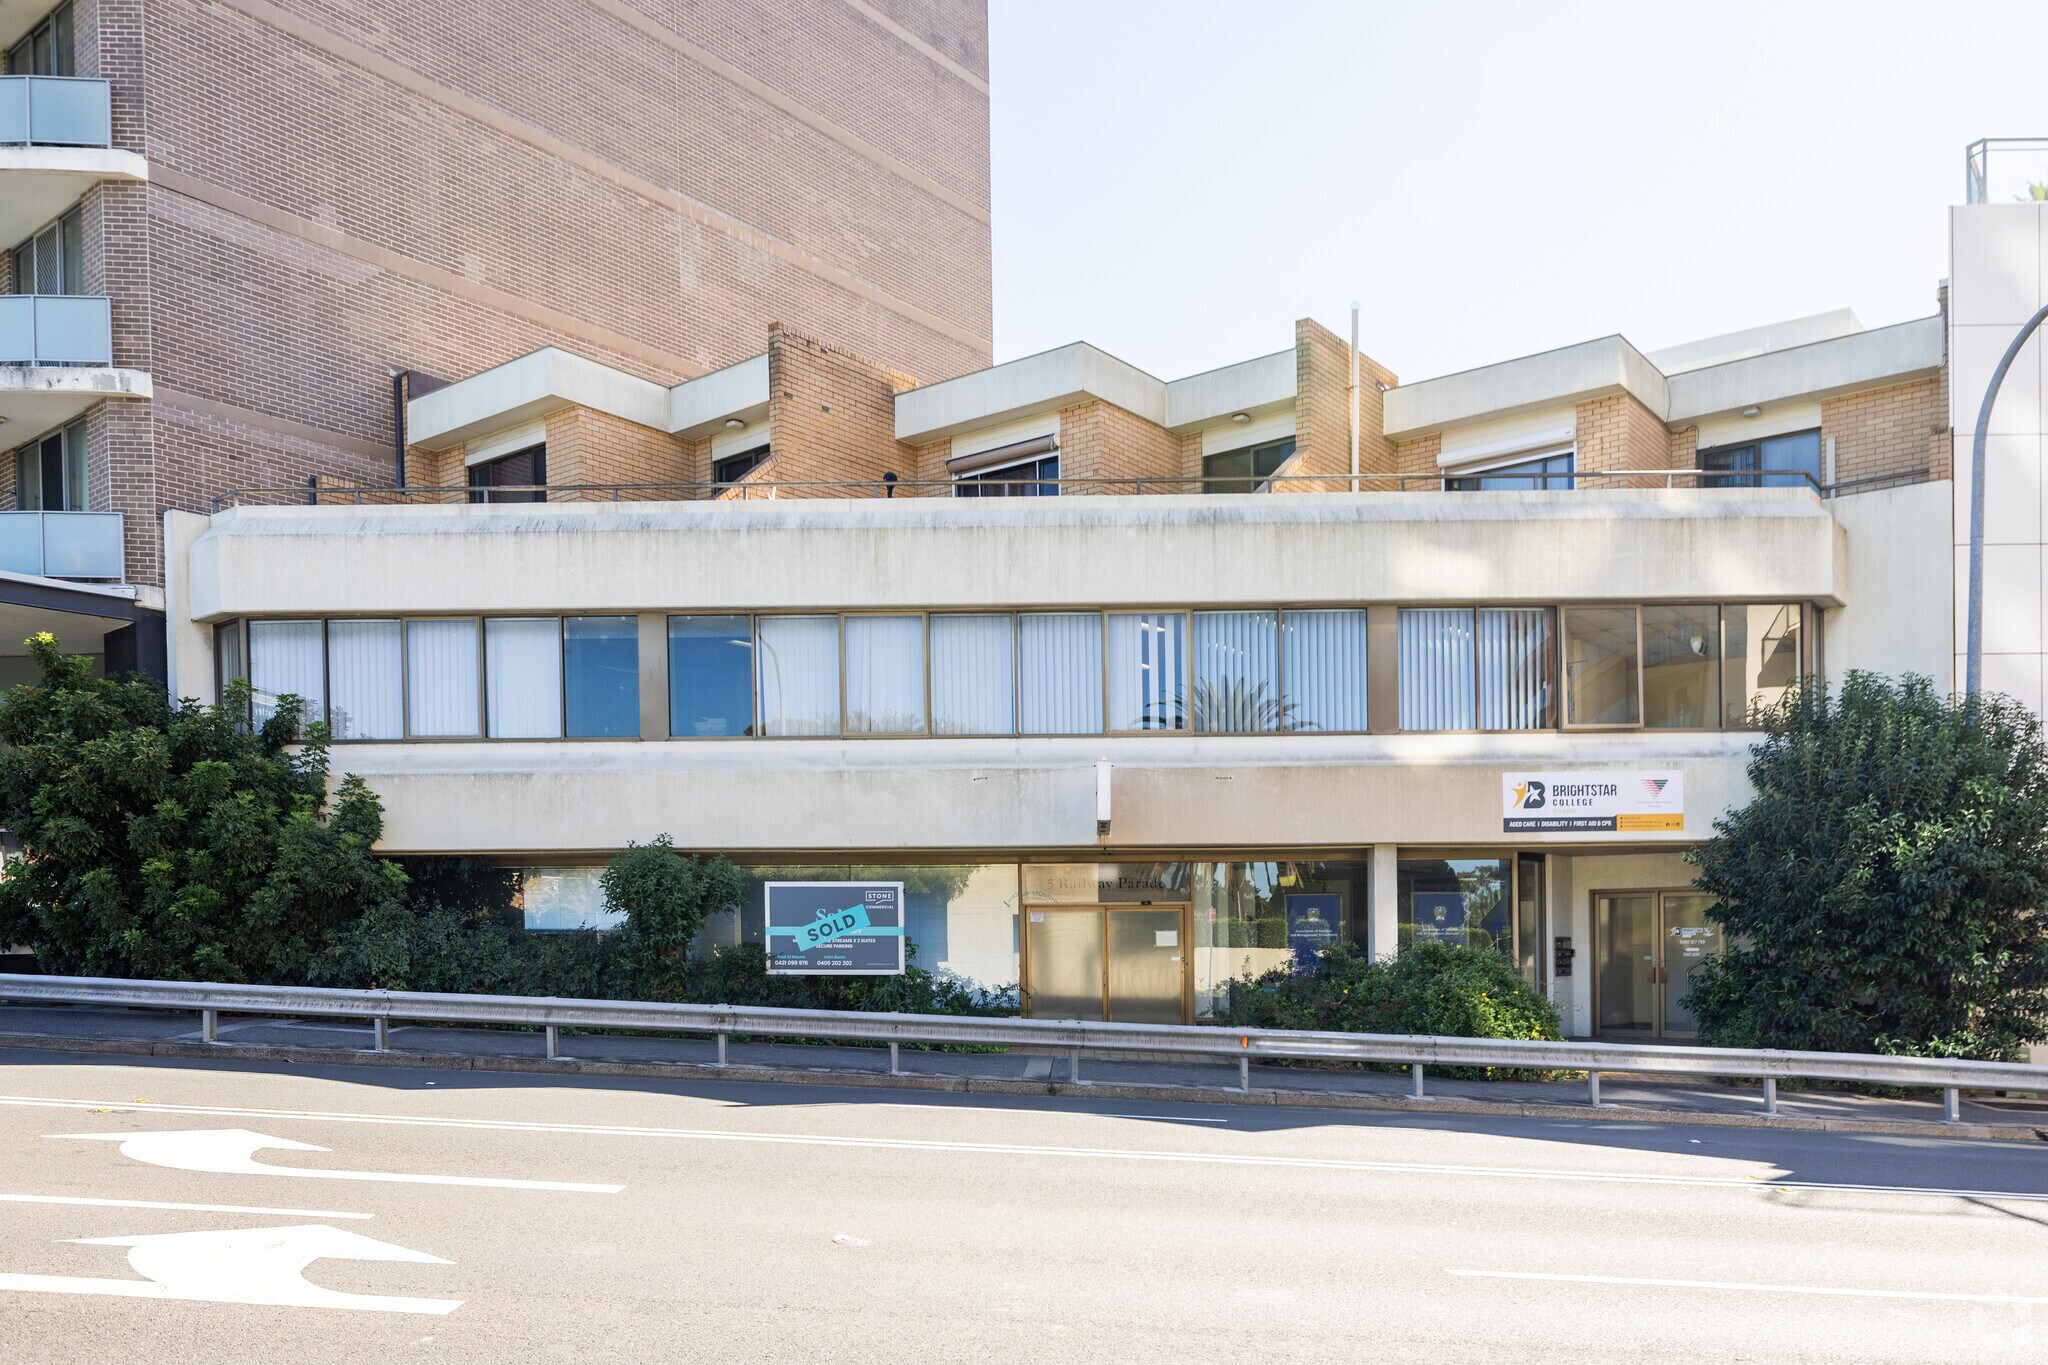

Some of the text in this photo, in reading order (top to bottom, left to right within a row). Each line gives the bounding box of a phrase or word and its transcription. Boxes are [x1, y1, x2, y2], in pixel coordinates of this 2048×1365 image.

[1552, 784, 1617, 797] BRIGHTSTAR
[1552, 798, 1593, 807] COLLEGE
[1509, 820, 1522, 828] AGED
[1523, 820, 1536, 828] CARE
[1541, 820, 1568, 828] DISABILITY
[1047, 877, 1166, 891] 5 Railway Parade
[807, 914, 856, 942] SOLD
